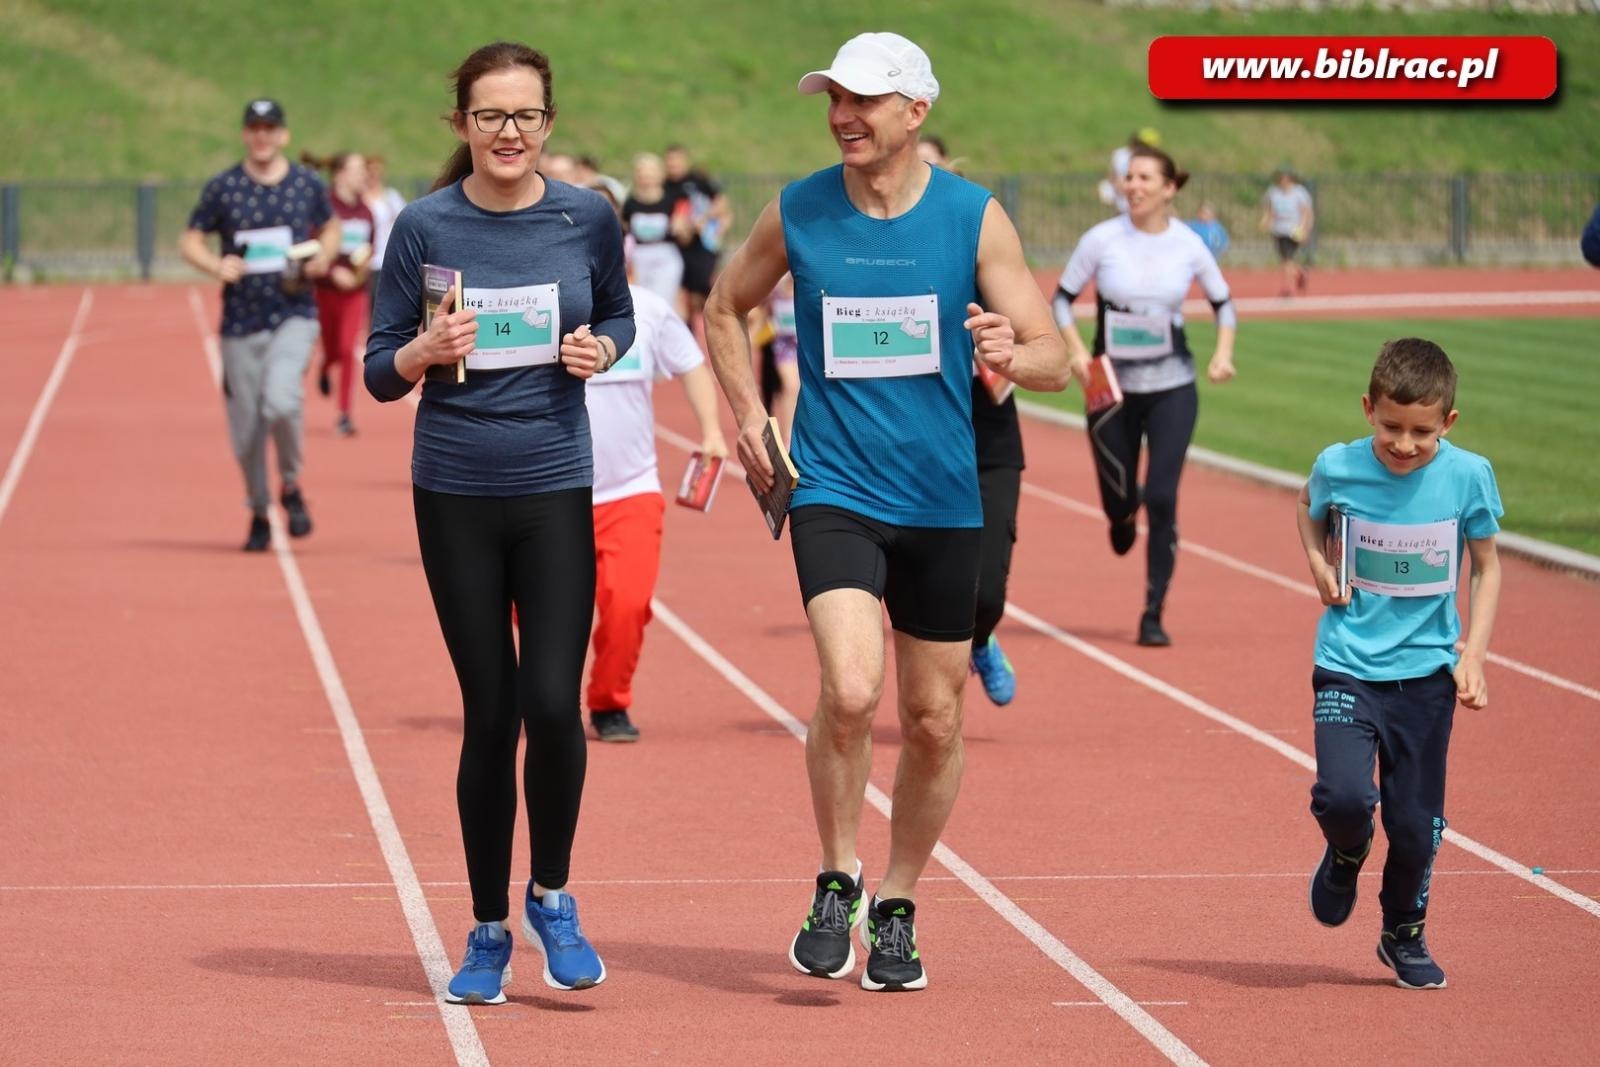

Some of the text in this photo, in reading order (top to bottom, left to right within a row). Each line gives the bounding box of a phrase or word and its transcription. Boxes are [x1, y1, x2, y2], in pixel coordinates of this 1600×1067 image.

[463, 298, 484, 308] ieg
[836, 307, 861, 317] Bieg
[494, 322, 512, 336] 14
[873, 331, 889, 345] 12
[1360, 535, 1384, 547] Bieg
[1394, 561, 1409, 574] 13
[1341, 692, 1355, 703] ONE
[1432, 817, 1441, 828] NO
